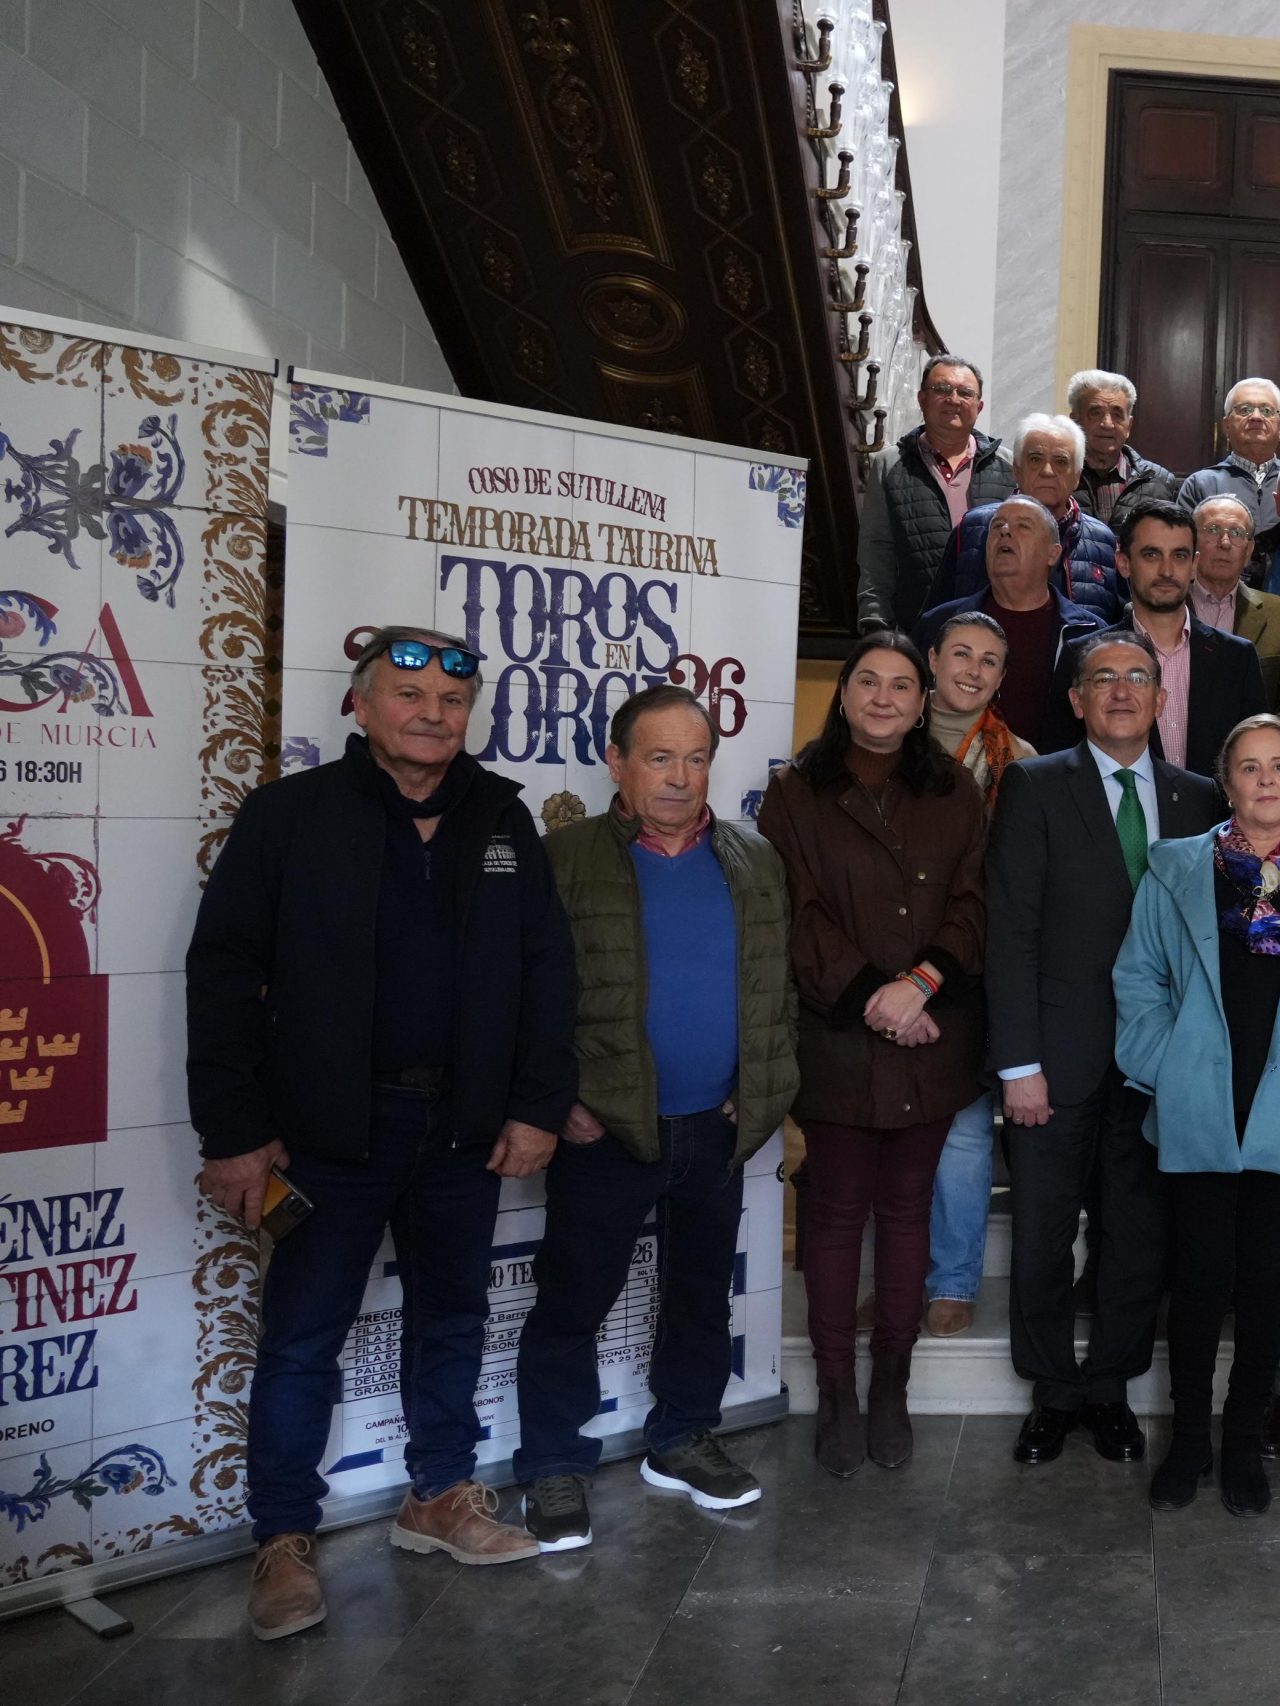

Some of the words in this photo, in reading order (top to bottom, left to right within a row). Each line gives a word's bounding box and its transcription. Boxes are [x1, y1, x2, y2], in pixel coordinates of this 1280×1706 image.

[468, 466, 520, 494] COSO
[523, 468, 552, 495] DE
[557, 471, 668, 522] SUTULLENA
[399, 496, 595, 562] TEMPORADA
[598, 522, 721, 577] TAURINA
[441, 555, 678, 674] TOROS
[604, 642, 632, 670] EN
[0, 722, 21, 744] E
[41, 723, 157, 748] MURCIA
[15, 760, 82, 784] 18:30H
[508, 1261, 535, 1287] TE
[355, 1325, 382, 1337] FILA
[355, 1335, 382, 1347] FILA
[355, 1344, 382, 1356] FILA
[355, 1354, 382, 1366] FILA
[355, 1362, 398, 1377] PALCO
[354, 1382, 399, 1397] GRADA
